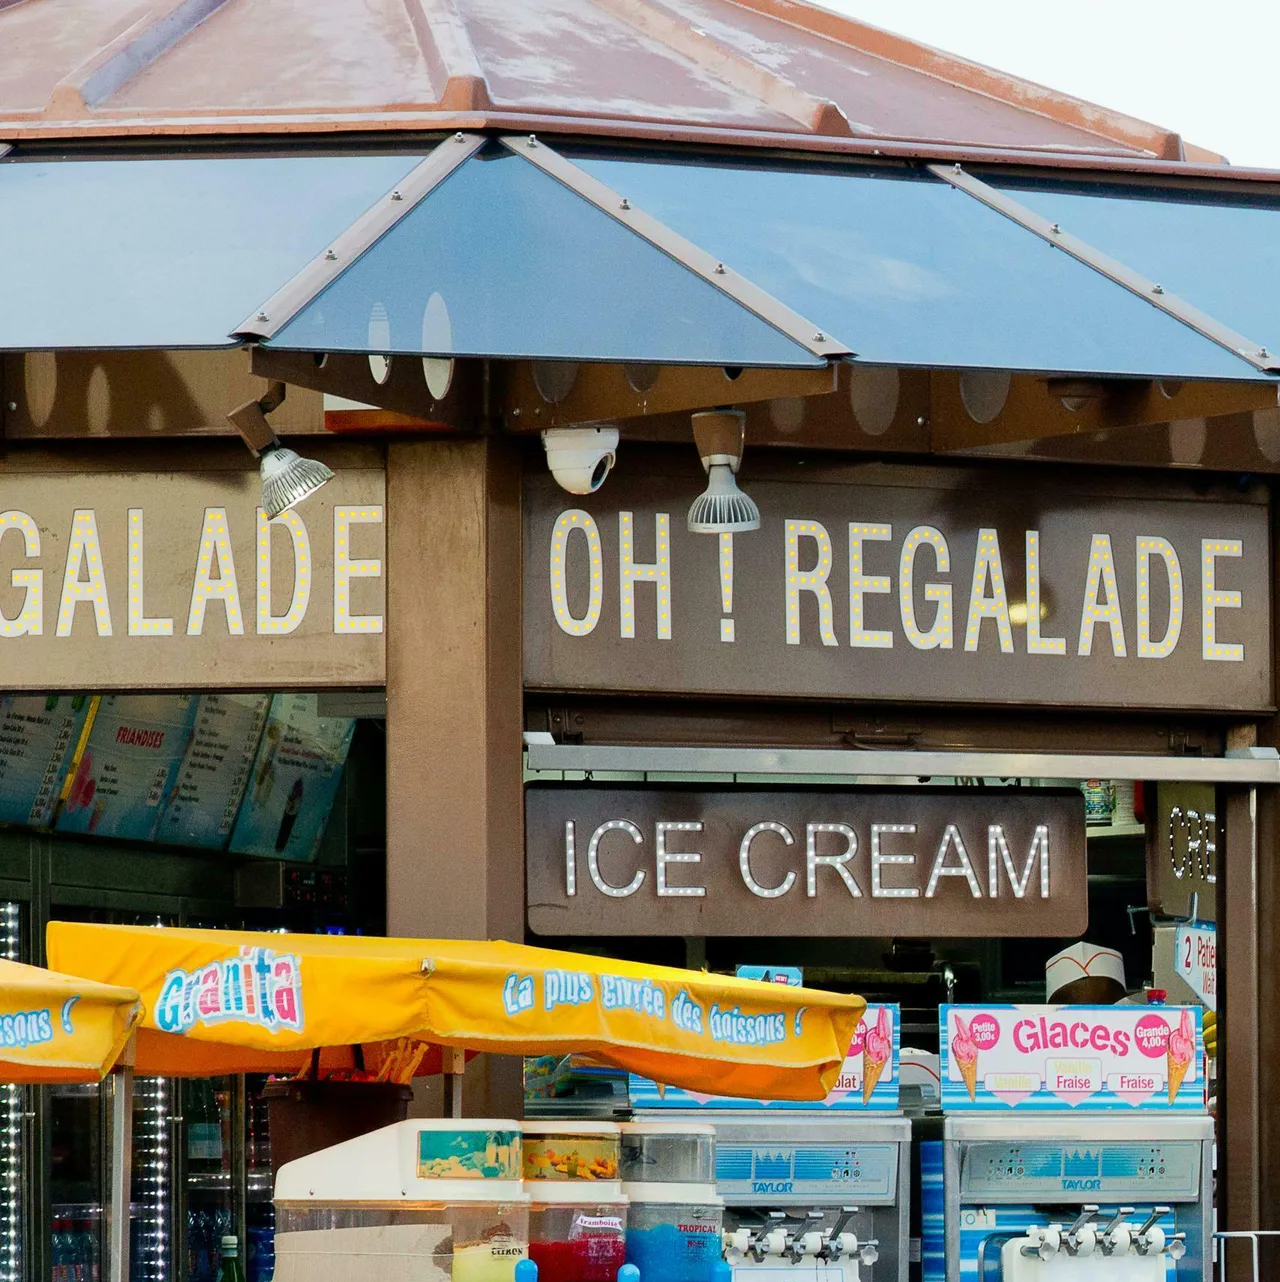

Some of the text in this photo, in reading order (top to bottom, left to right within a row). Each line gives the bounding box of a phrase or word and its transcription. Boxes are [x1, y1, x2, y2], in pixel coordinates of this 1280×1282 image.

[549, 508, 673, 641] OH
[783, 518, 1245, 662] REGALADE
[565, 819, 1051, 899] ICE CREAM
[1184, 935, 1192, 968] 2
[155, 945, 303, 1034] Granita
[503, 973, 535, 1017] La
[544, 969, 594, 1012] plus
[671, 991, 703, 1036] des
[708, 1003, 787, 1047] boissons
[972, 1021, 996, 1033] Petite
[1136, 1026, 1170, 1038] Grande
[1012, 1016, 1131, 1058] Glaces
[1056, 1075, 1091, 1089] Fraise
[1120, 1075, 1154, 1089] Fraise
[752, 1182, 793, 1193] TAYLOR
[1061, 1179, 1101, 1190] TAYLOR
[677, 1223, 717, 1234] TROPICAL
